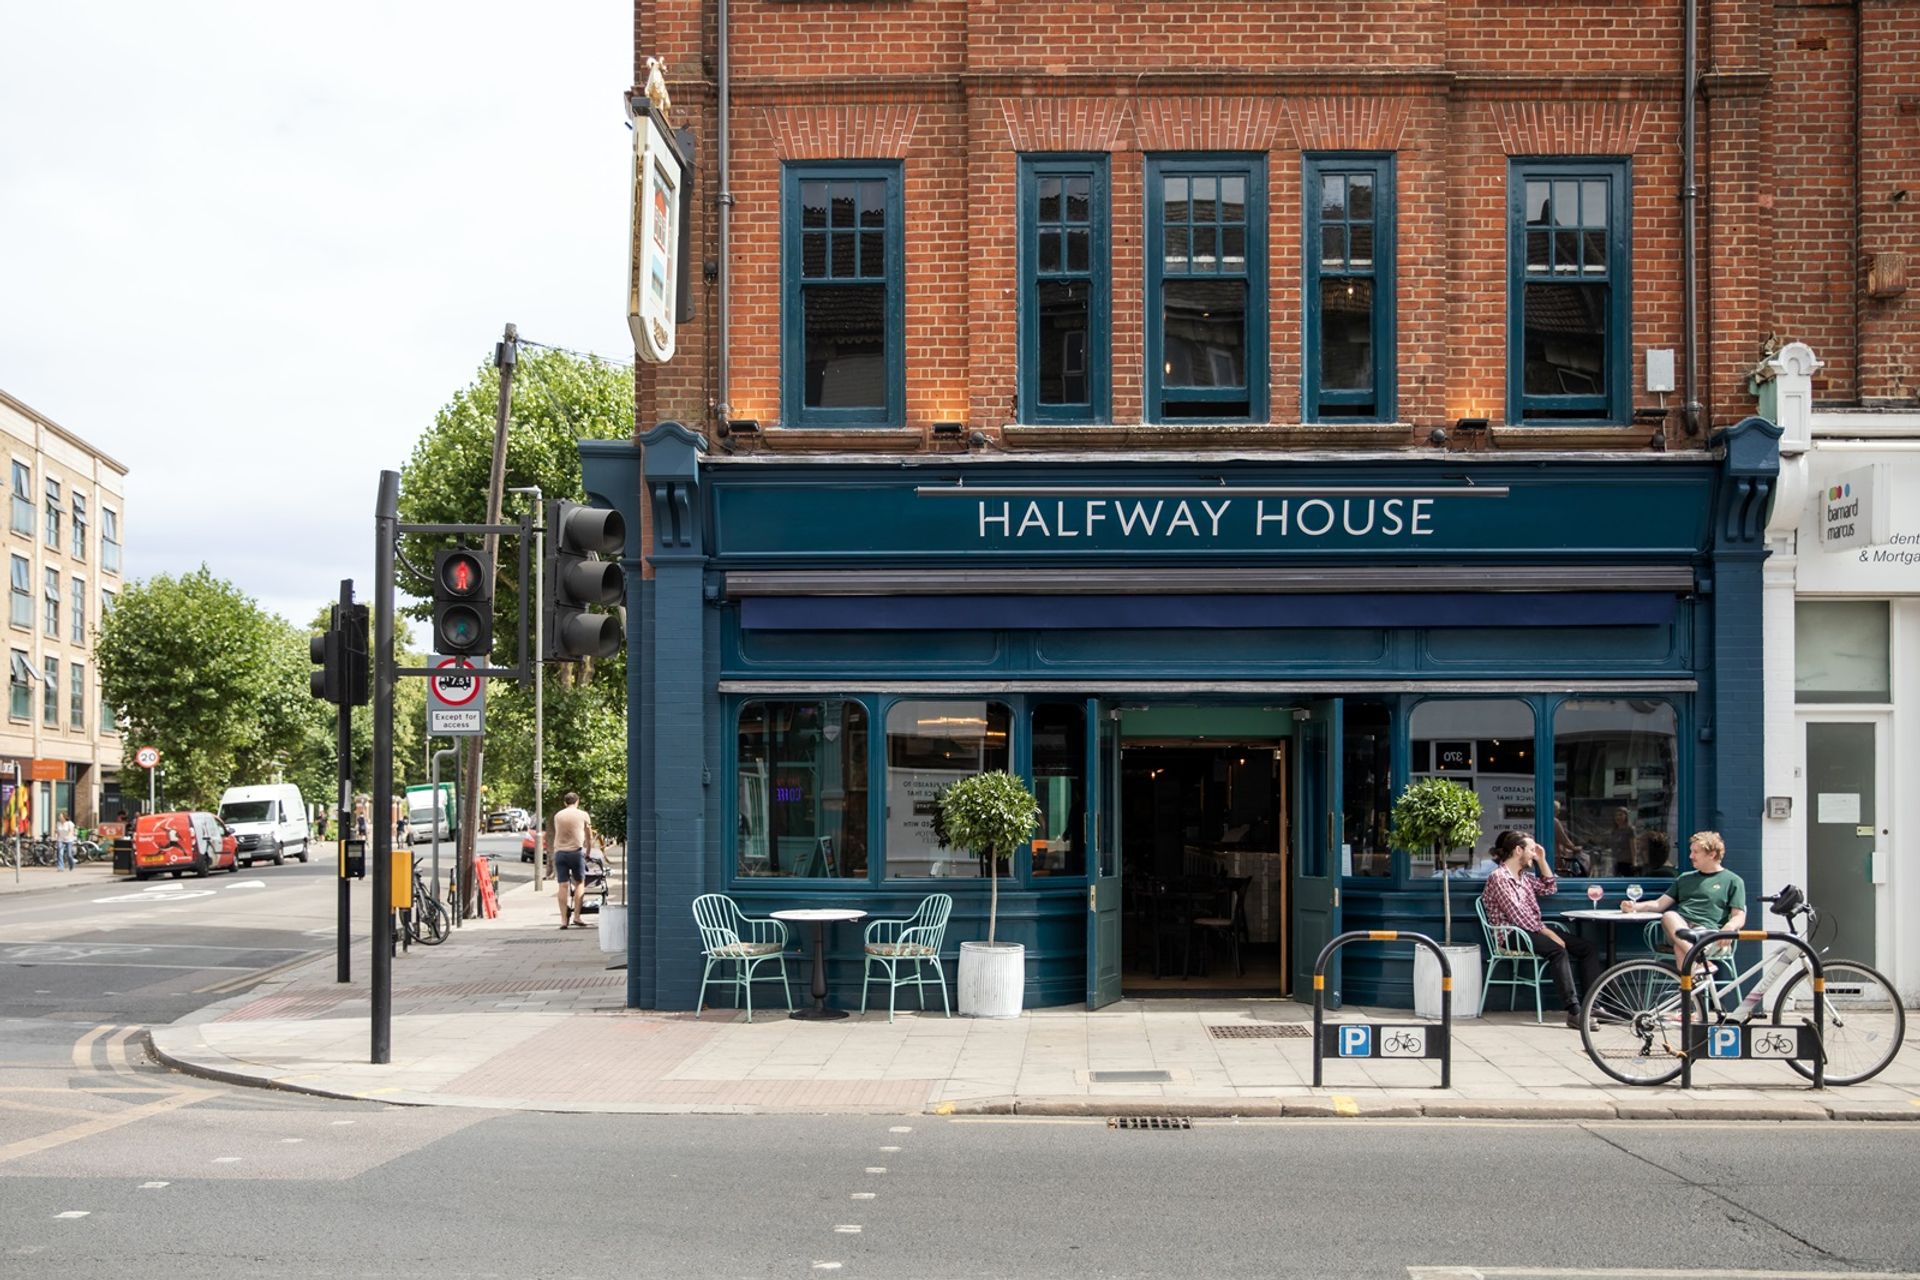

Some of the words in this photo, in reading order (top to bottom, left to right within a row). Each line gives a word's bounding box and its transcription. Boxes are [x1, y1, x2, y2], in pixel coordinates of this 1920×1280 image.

[978, 500, 1232, 537] HALFWAY
[1256, 498, 1435, 536] HOUSE
[1827, 497, 1858, 522] barnard
[1827, 523, 1855, 541] marcus
[1858, 549, 1869, 562] &
[435, 713, 462, 722] Except
[465, 713, 477, 721] for
[140, 752, 156, 762] 20
[1345, 1028, 1366, 1055] P
[1714, 1030, 1736, 1056] P
